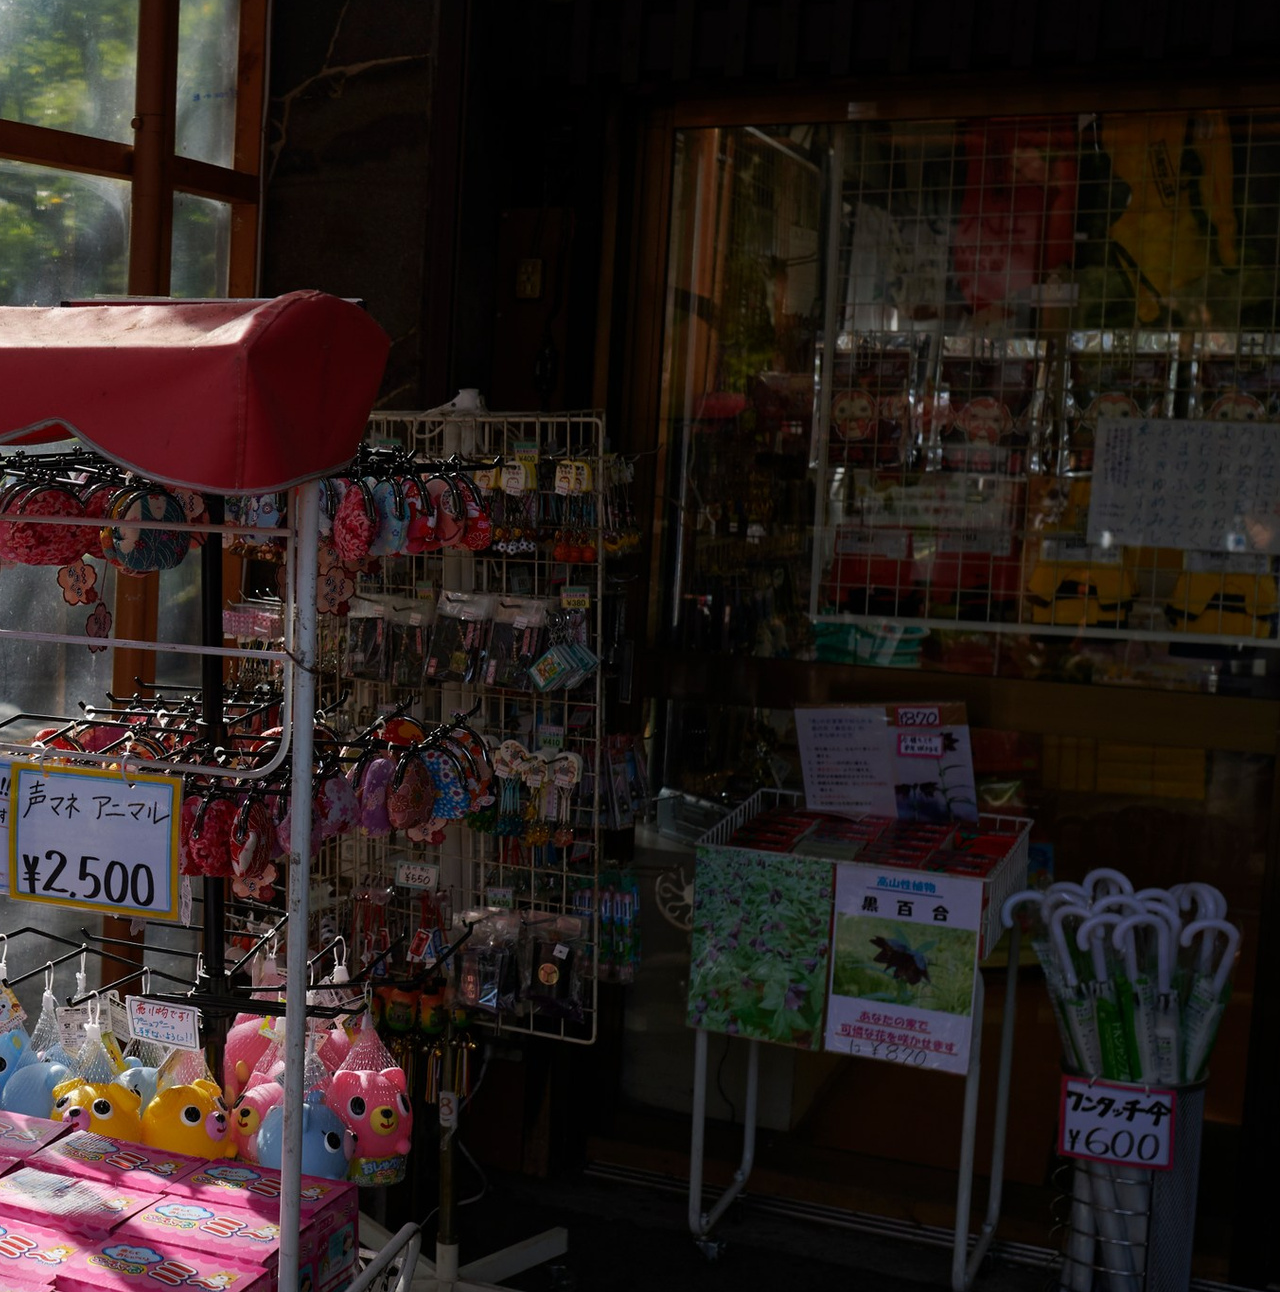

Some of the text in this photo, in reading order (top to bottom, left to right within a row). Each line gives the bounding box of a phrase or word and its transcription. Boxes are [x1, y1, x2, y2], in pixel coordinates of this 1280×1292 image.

[23, 780, 170, 825] 声マネ アニマル
[405, 871, 431, 885] ¥550
[877, 876, 937, 893] 高山性植物
[1069, 1127, 1160, 1161] ¥600
